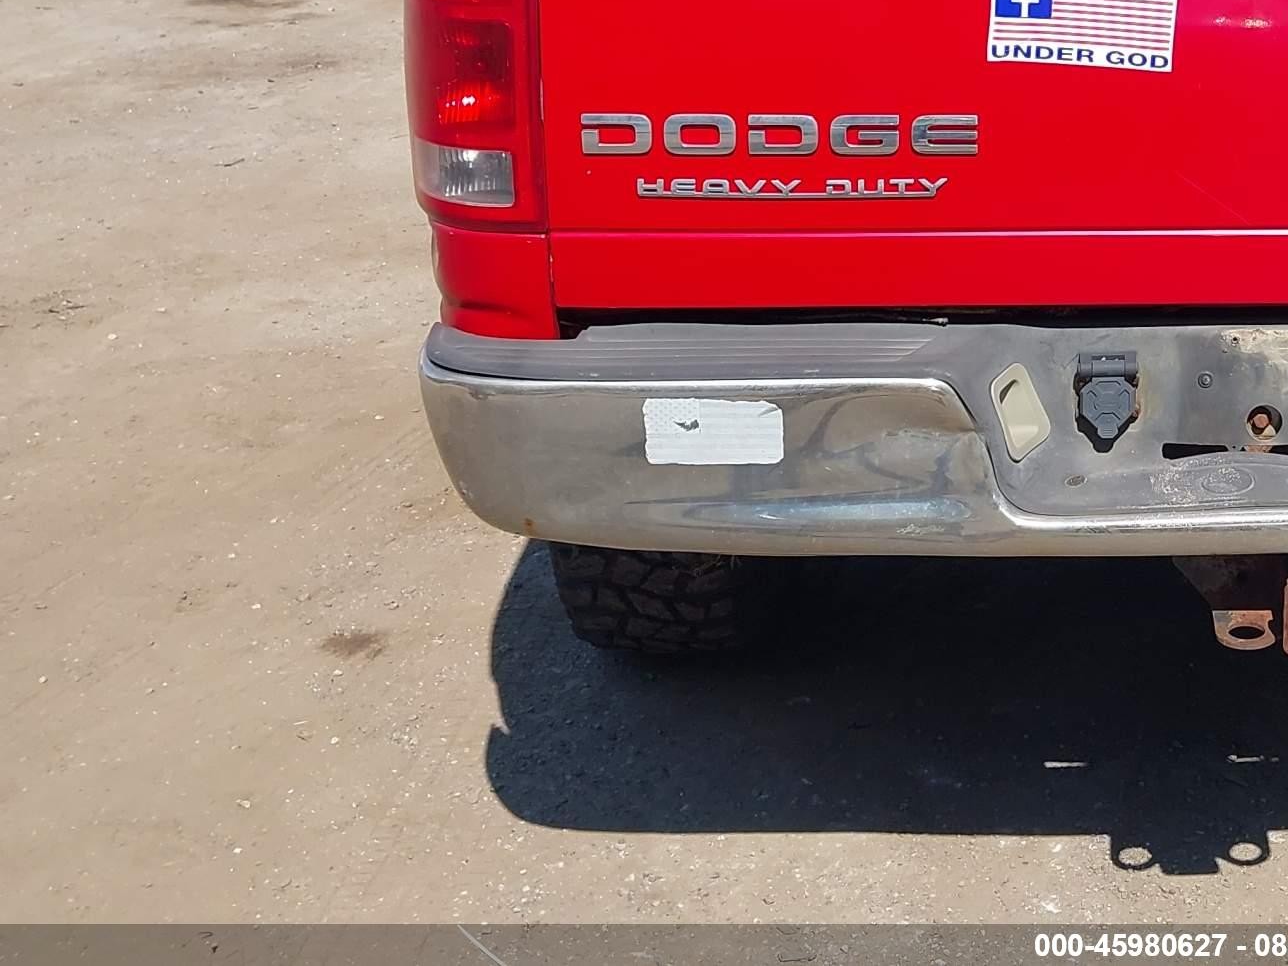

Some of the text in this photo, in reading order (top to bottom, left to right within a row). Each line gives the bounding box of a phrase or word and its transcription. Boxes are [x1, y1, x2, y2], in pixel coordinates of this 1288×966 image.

[991, 44, 1169, 69] UNDER GOD
[580, 113, 979, 155] DODGE
[636, 177, 949, 198] HEAVY DUTY
